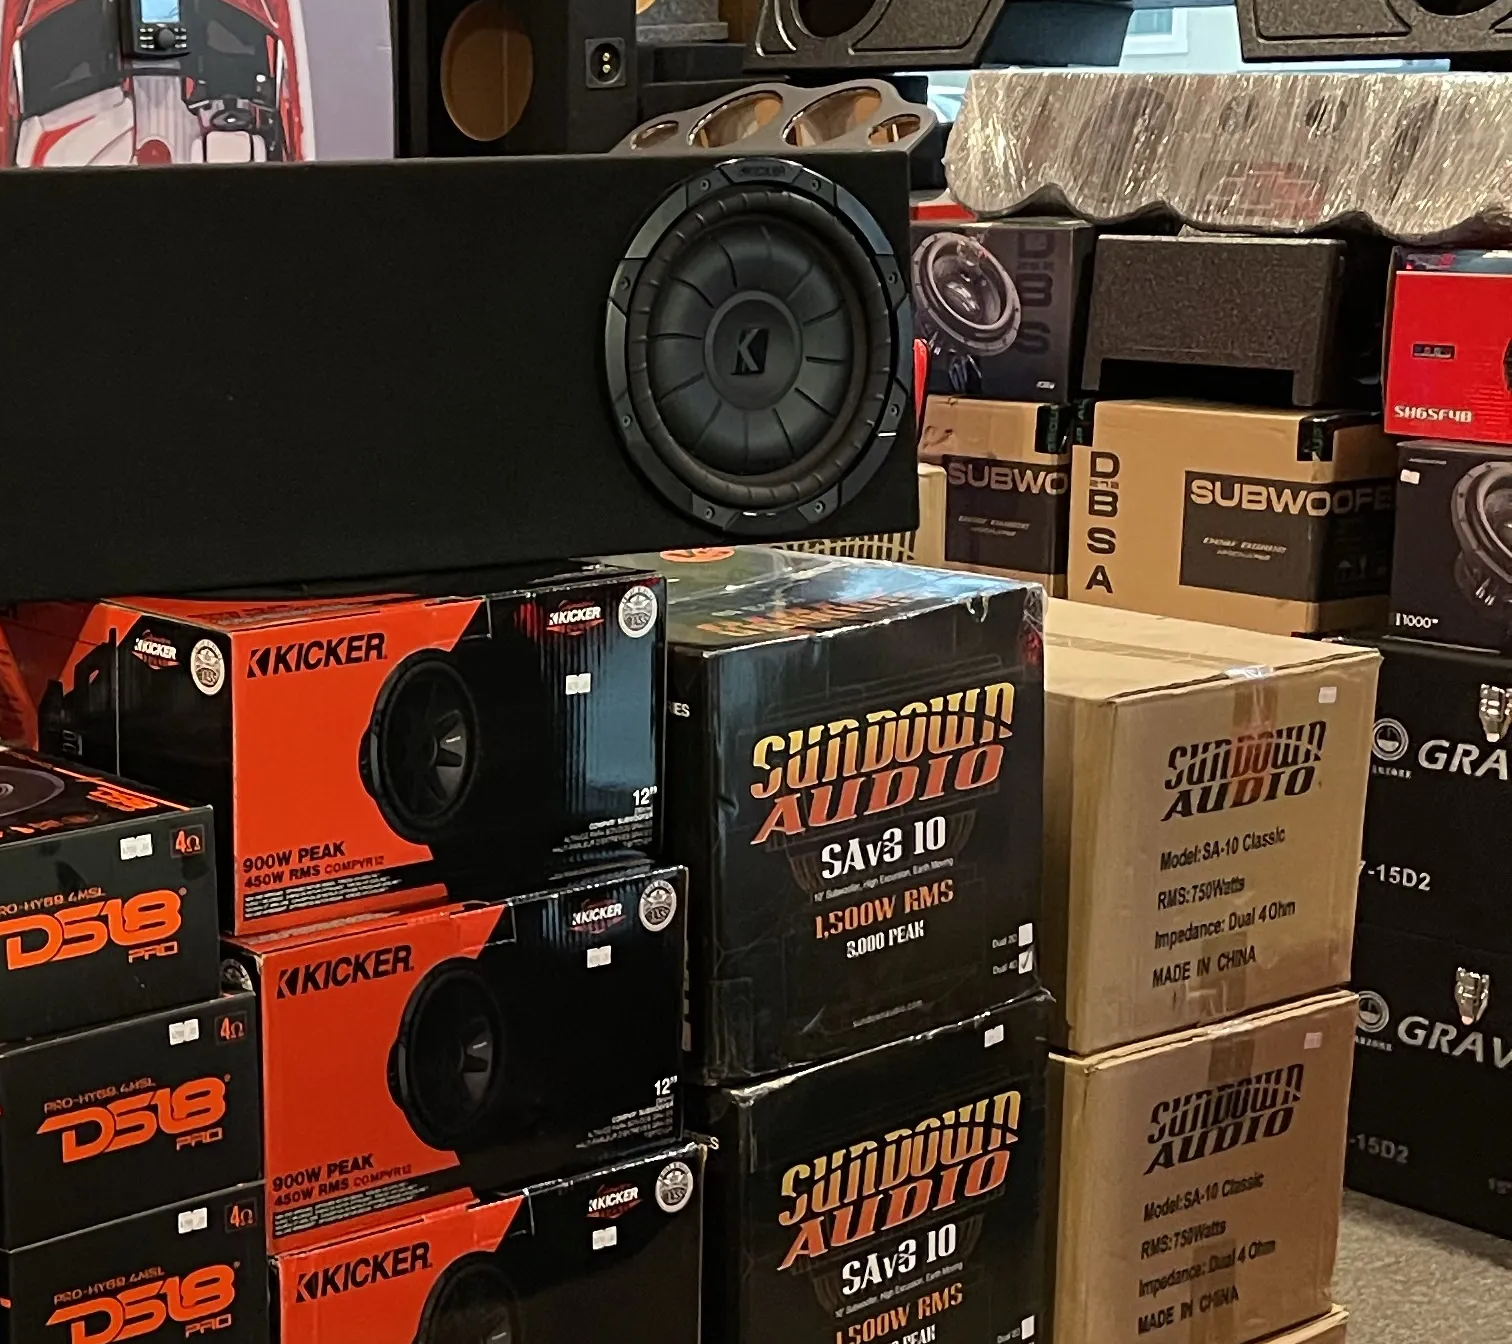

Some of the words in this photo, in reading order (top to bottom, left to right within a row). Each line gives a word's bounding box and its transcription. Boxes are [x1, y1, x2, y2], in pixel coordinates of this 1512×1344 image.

[557, 606, 602, 624] KICKER
[272, 631, 386, 675] KICKER
[749, 681, 1016, 800] SUNDOWN
[1164, 719, 1327, 791] SUNDOWN
[632, 785, 658, 806] 12"
[749, 743, 1005, 846] AUDIO
[1160, 764, 1315, 822] AUDIO
[912, 815, 948, 857] 10
[1242, 825, 1286, 851] Classic
[243, 850, 292, 875] 900W
[296, 840, 346, 862] PEAK
[244, 867, 287, 890] 450W
[289, 863, 320, 880] RMS
[580, 902, 623, 924] KICKER
[903, 878, 955, 915] RMS
[1154, 917, 1226, 950] Impedance:
[1228, 905, 1256, 930] Dual
[127, 940, 178, 964] PRO
[301, 944, 413, 995] KICKER
[1152, 960, 1191, 989] MADE
[1195, 955, 1211, 975] IN
[1217, 944, 1257, 973] CHINA
[653, 1075, 679, 1096] 12"
[1147, 1062, 1305, 1145] SUNDOWN
[36, 1076, 227, 1164] DS18
[175, 1127, 223, 1152] PRO
[1143, 1106, 1294, 1176] AUDIO
[271, 1169, 322, 1193] 900W
[325, 1154, 375, 1179] PEAK
[778, 1090, 1022, 1227] SUNDOWN
[273, 1186, 316, 1208] 450W
[318, 1180, 349, 1198] RMS
[597, 1186, 639, 1211] KICKER
[776, 1149, 1011, 1271] AUDIO
[925, 1223, 957, 1265] 10
[319, 1241, 431, 1297] KICKER
[916, 1282, 964, 1320] RMS
[1138, 1305, 1175, 1336] MADE
[1199, 1285, 1240, 1314] CHINA
[184, 1313, 232, 1339] PRO
